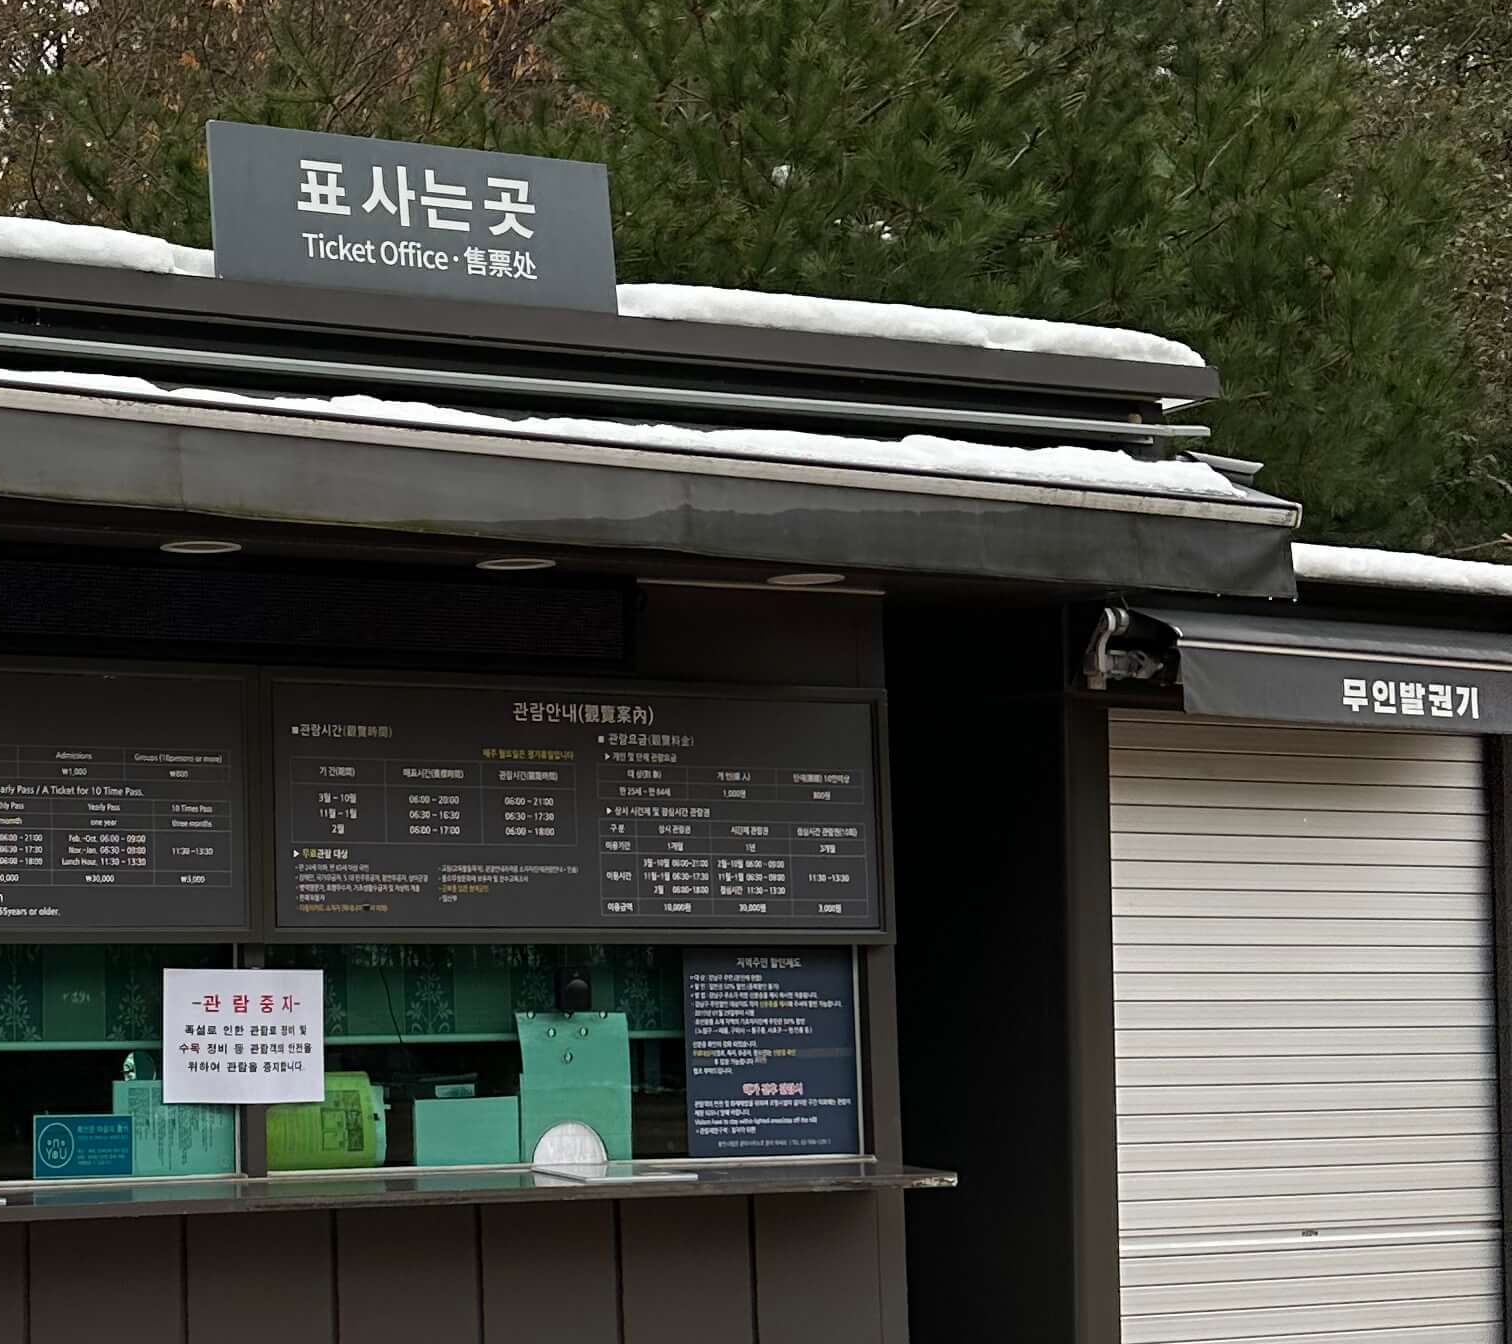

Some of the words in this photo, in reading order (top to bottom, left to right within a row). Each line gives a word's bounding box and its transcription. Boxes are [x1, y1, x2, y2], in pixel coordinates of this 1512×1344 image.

[297, 158, 350, 216] 표
[361, 165, 472, 233] 사는
[484, 176, 536, 240] 곳
[302, 232, 376, 264] Ticket
[382, 240, 449, 270] Office
[1342, 678, 1479, 719] 무인발권기
[18, 786, 34, 794] Pass
[42, 787, 48, 795] A
[51, 786, 77, 796] Ticket
[80, 787, 88, 796] for
[91, 787, 101, 796] 10
[104, 787, 123, 796] Time
[126, 788, 144, 797] Pass.
[233, 995, 248, 1013] 람
[260, 995, 274, 1013] 중
[223, 1025, 244, 1036] 인한
[250, 1025, 277, 1036] 관람로
[280, 1025, 296, 1036] 정비
[179, 1042, 200, 1055] 수목
[207, 1043, 227, 1055] 정비
[235, 1043, 244, 1054] 등
[287, 1042, 312, 1054] 안전을
[188, 1061, 220, 1072] 위하여
[227, 1061, 257, 1073] 관람을
